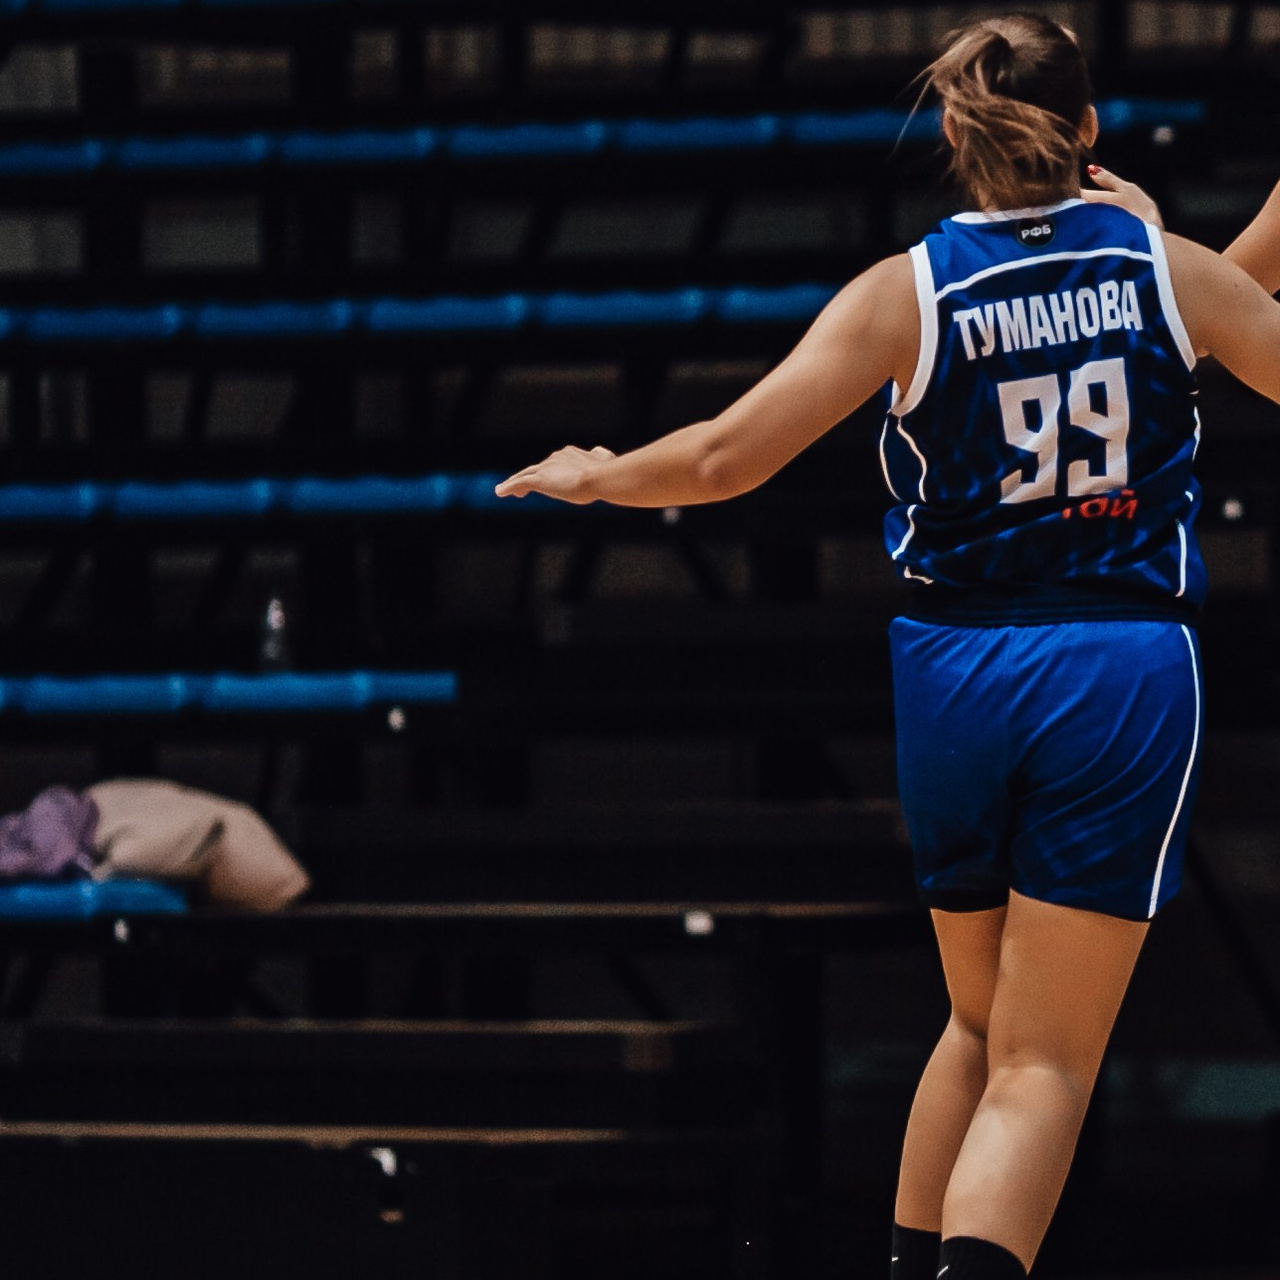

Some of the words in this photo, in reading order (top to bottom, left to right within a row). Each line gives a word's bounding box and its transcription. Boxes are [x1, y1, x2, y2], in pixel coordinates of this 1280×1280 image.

[1021, 224, 1051, 239] РФБ
[953, 279, 1144, 360] ТУМАНОВА
[997, 357, 1130, 504] 99
